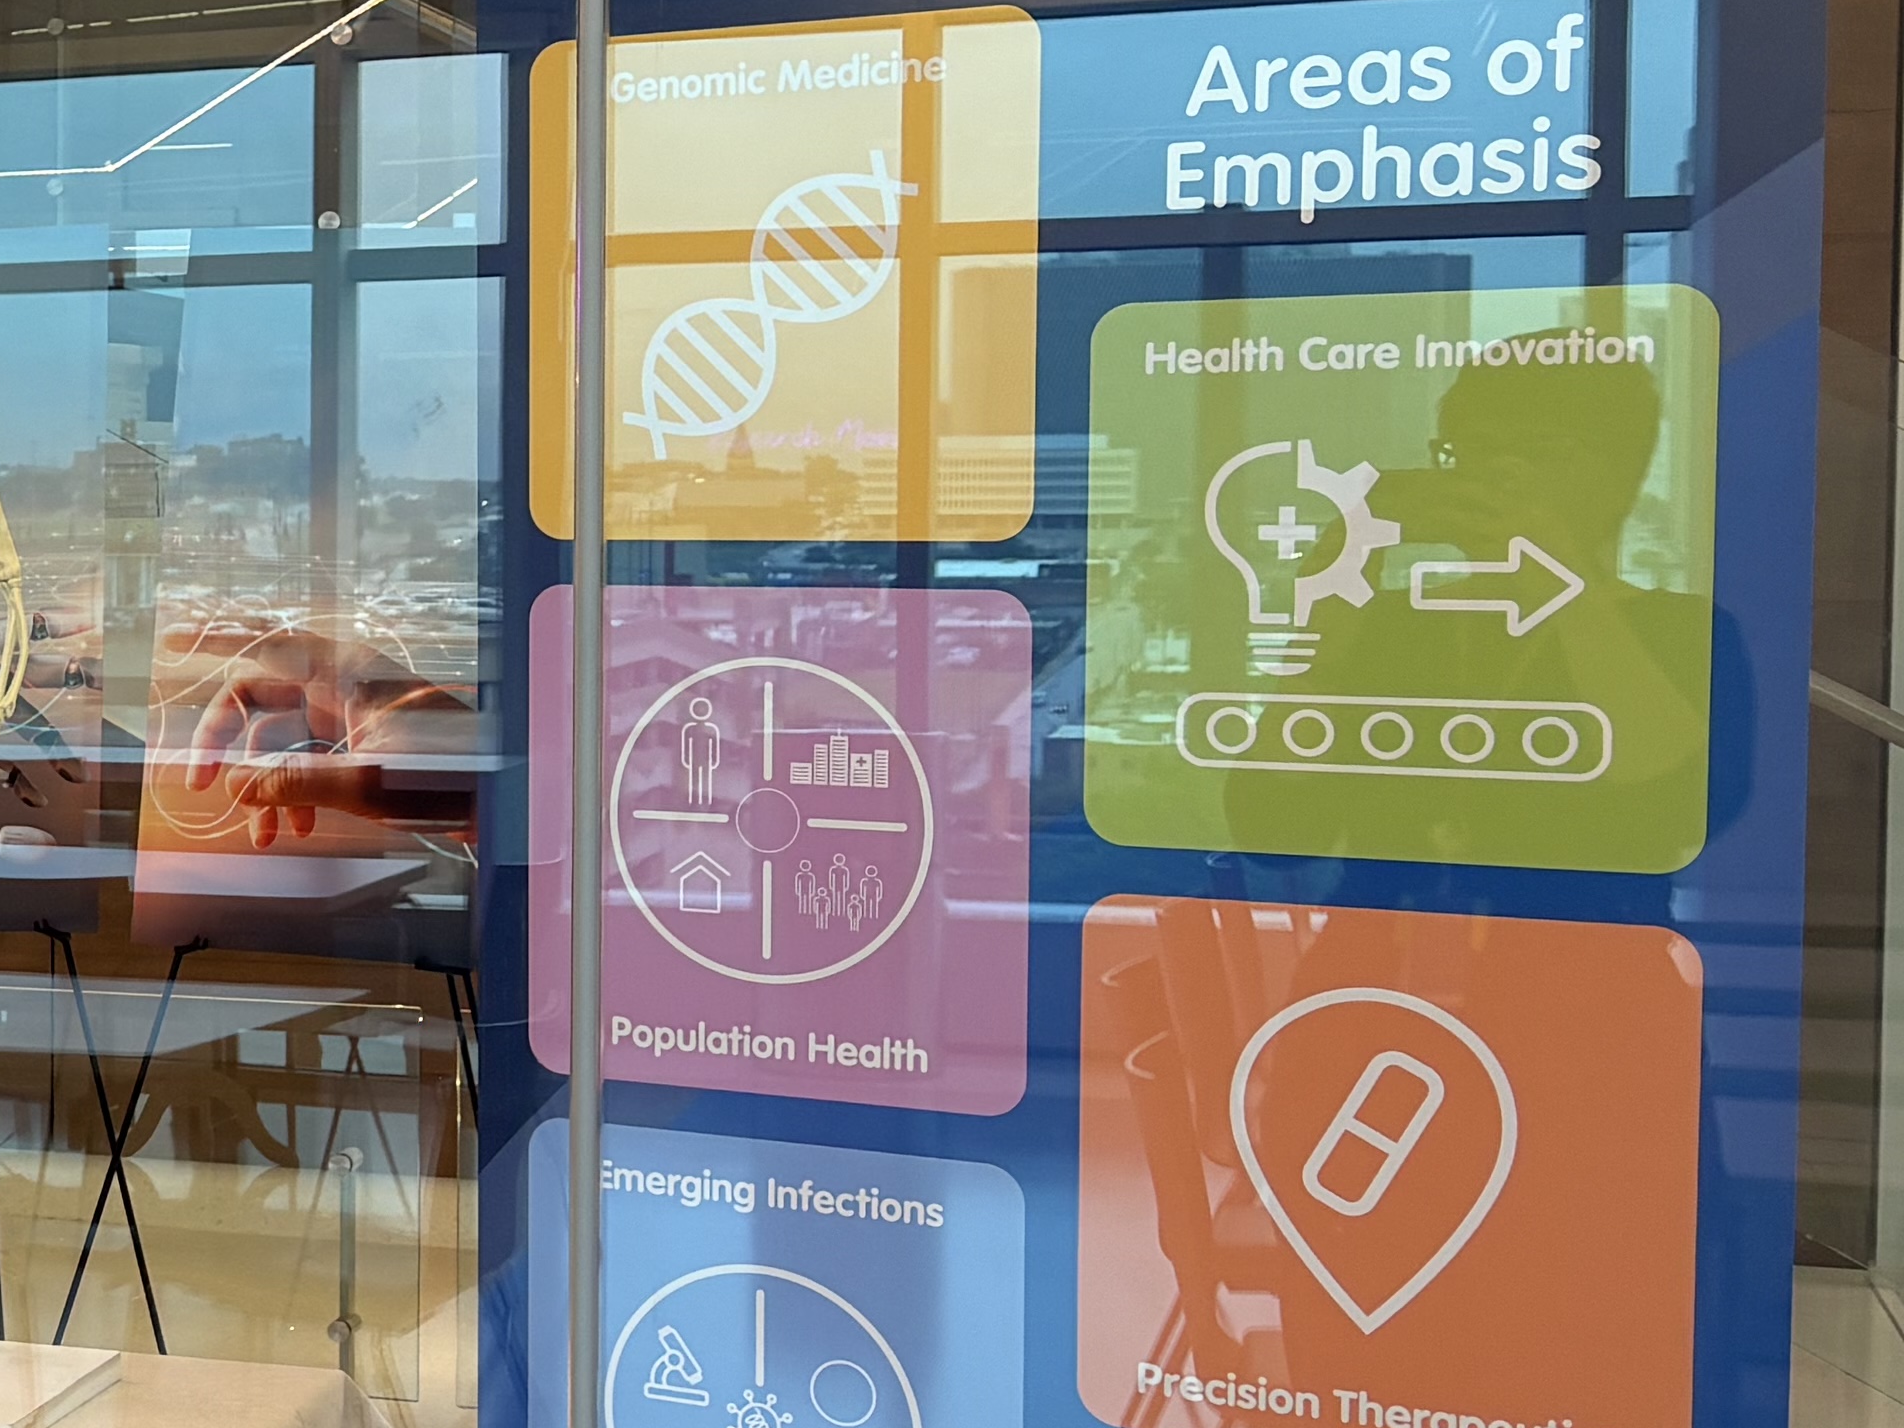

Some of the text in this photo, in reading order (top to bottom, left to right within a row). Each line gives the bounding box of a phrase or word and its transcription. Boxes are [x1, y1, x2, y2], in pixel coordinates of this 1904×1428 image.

[610, 50, 948, 106] Genomic Medicine
[1187, 13, 1588, 118] Areas of
[1166, 118, 1603, 225] Emphasis
[1144, 328, 1655, 375] Health Care Innovation
[611, 1016, 930, 1075] Population Health
[597, 1159, 945, 1229] Emerging Infections
[1135, 1363, 1319, 1423] Precision
